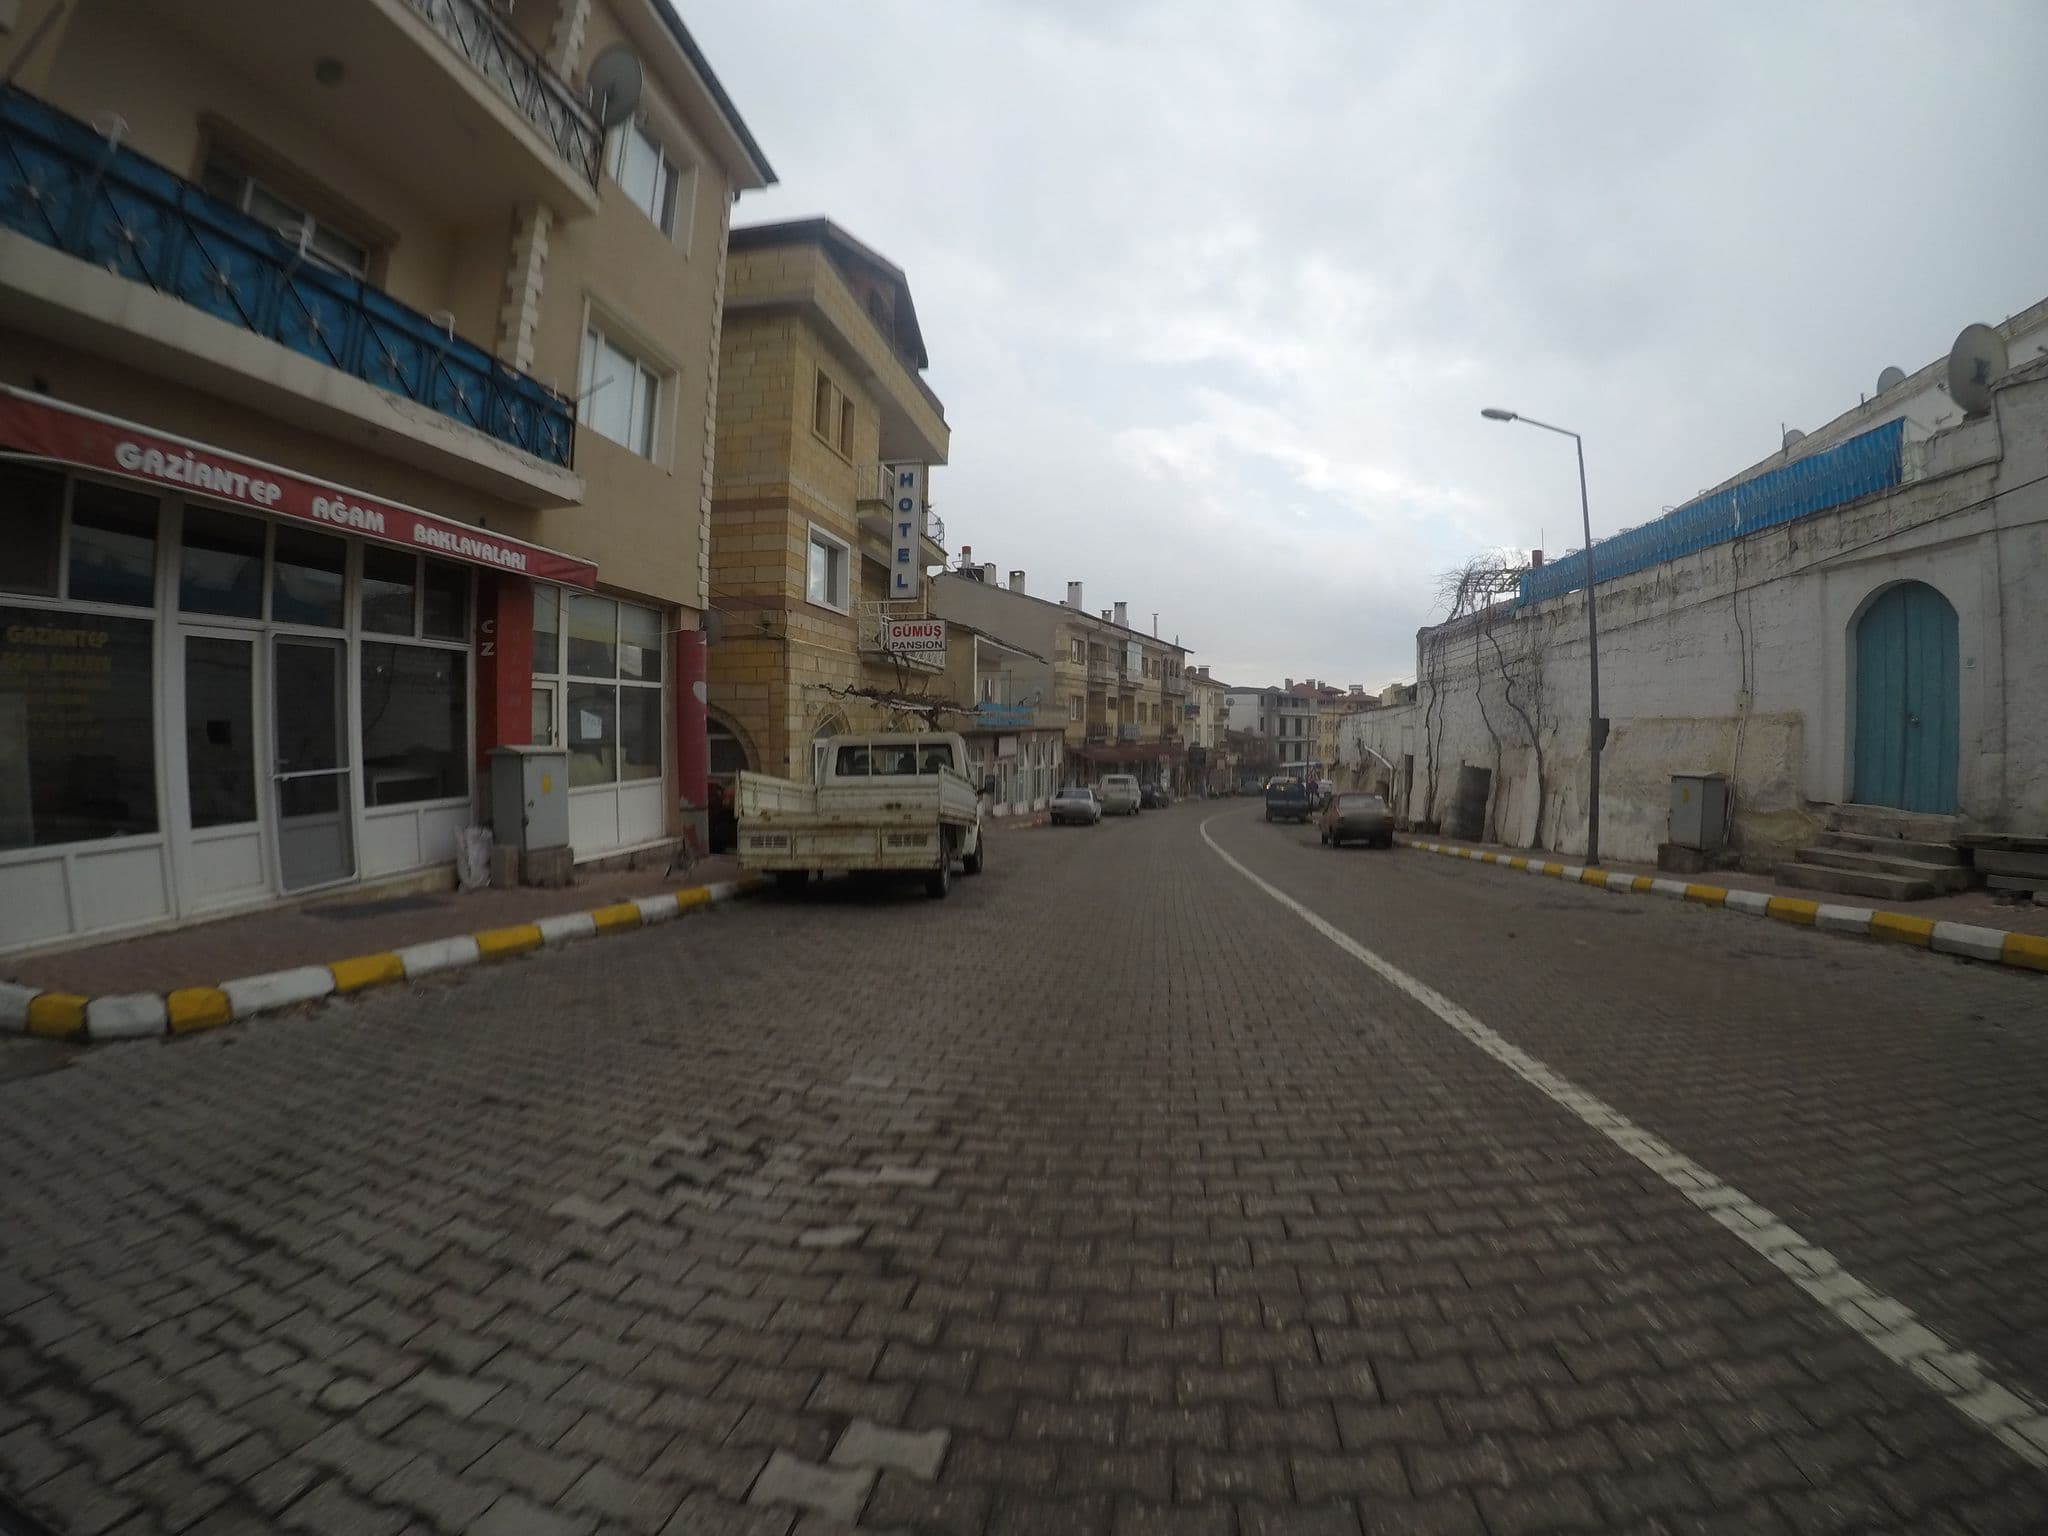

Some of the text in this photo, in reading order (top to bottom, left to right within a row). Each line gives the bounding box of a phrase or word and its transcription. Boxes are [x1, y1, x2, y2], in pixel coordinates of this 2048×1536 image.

[114, 441, 282, 506] GAZİANTEP
[413, 524, 527, 570] BAKLAVALARI
[896, 472, 914, 589] HOTEL
[892, 623, 942, 640] GÜMÜŞ
[892, 640, 943, 650] PANSION
